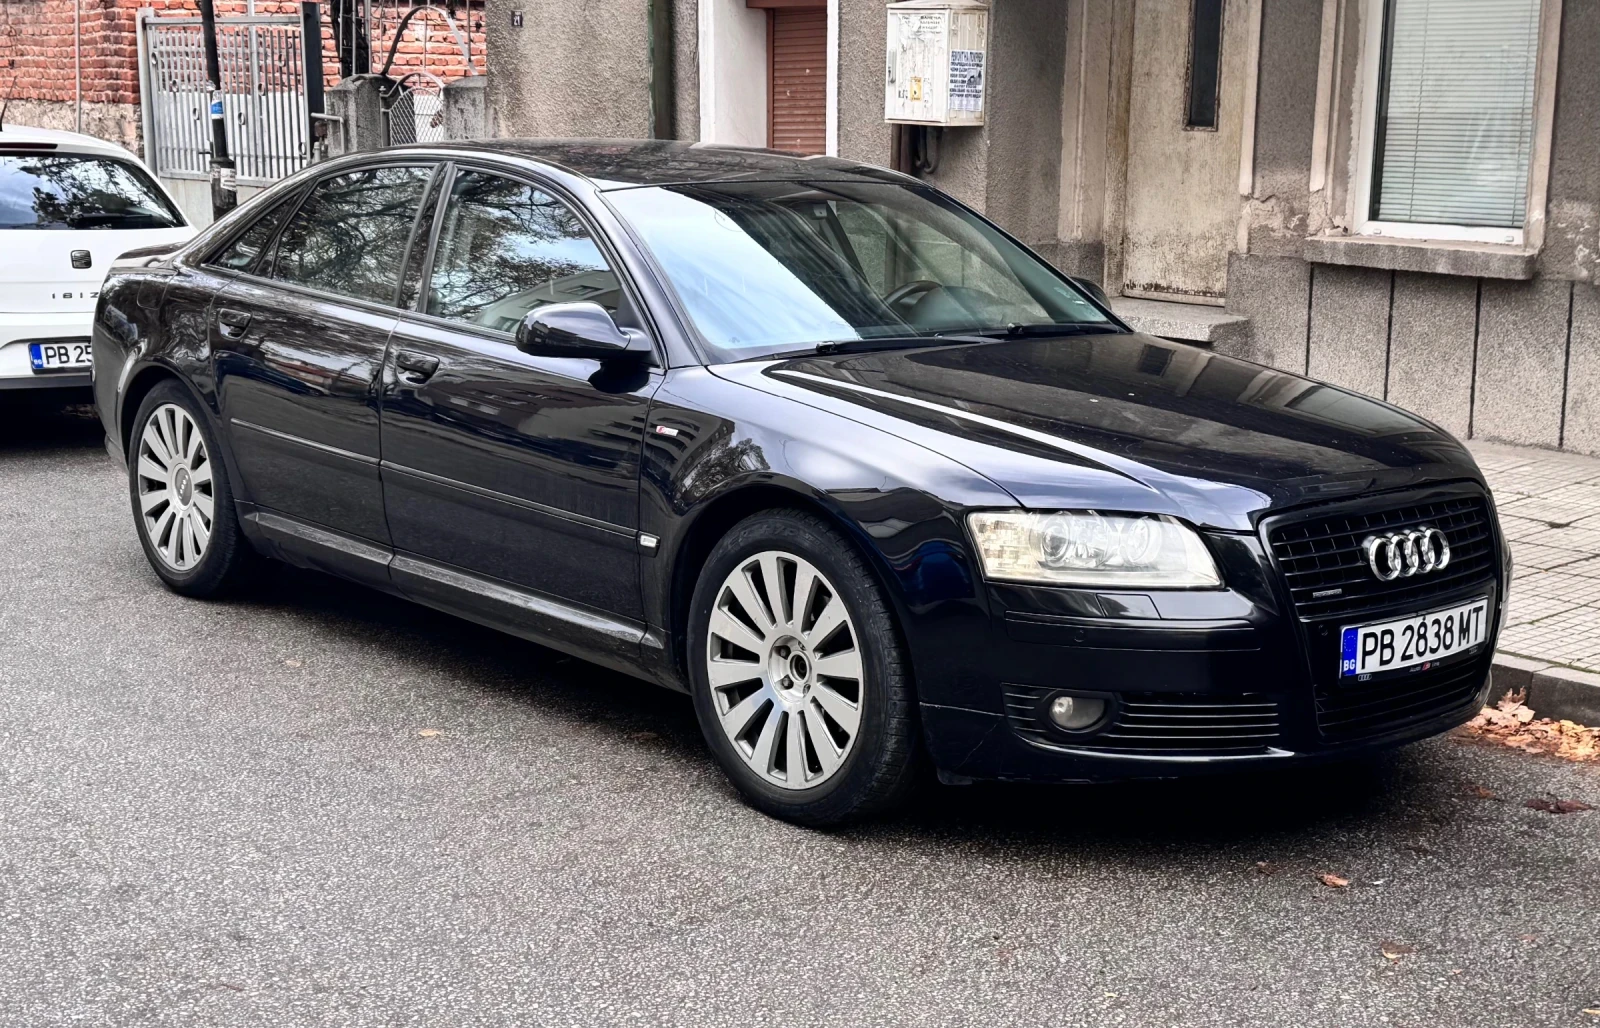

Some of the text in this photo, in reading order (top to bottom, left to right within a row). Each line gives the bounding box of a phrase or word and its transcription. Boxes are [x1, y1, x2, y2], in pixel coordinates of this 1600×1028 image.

[44, 346, 70, 365] PB
[1361, 605, 1484, 670] PB 2838 MT
[1343, 659, 1356, 672] BG
